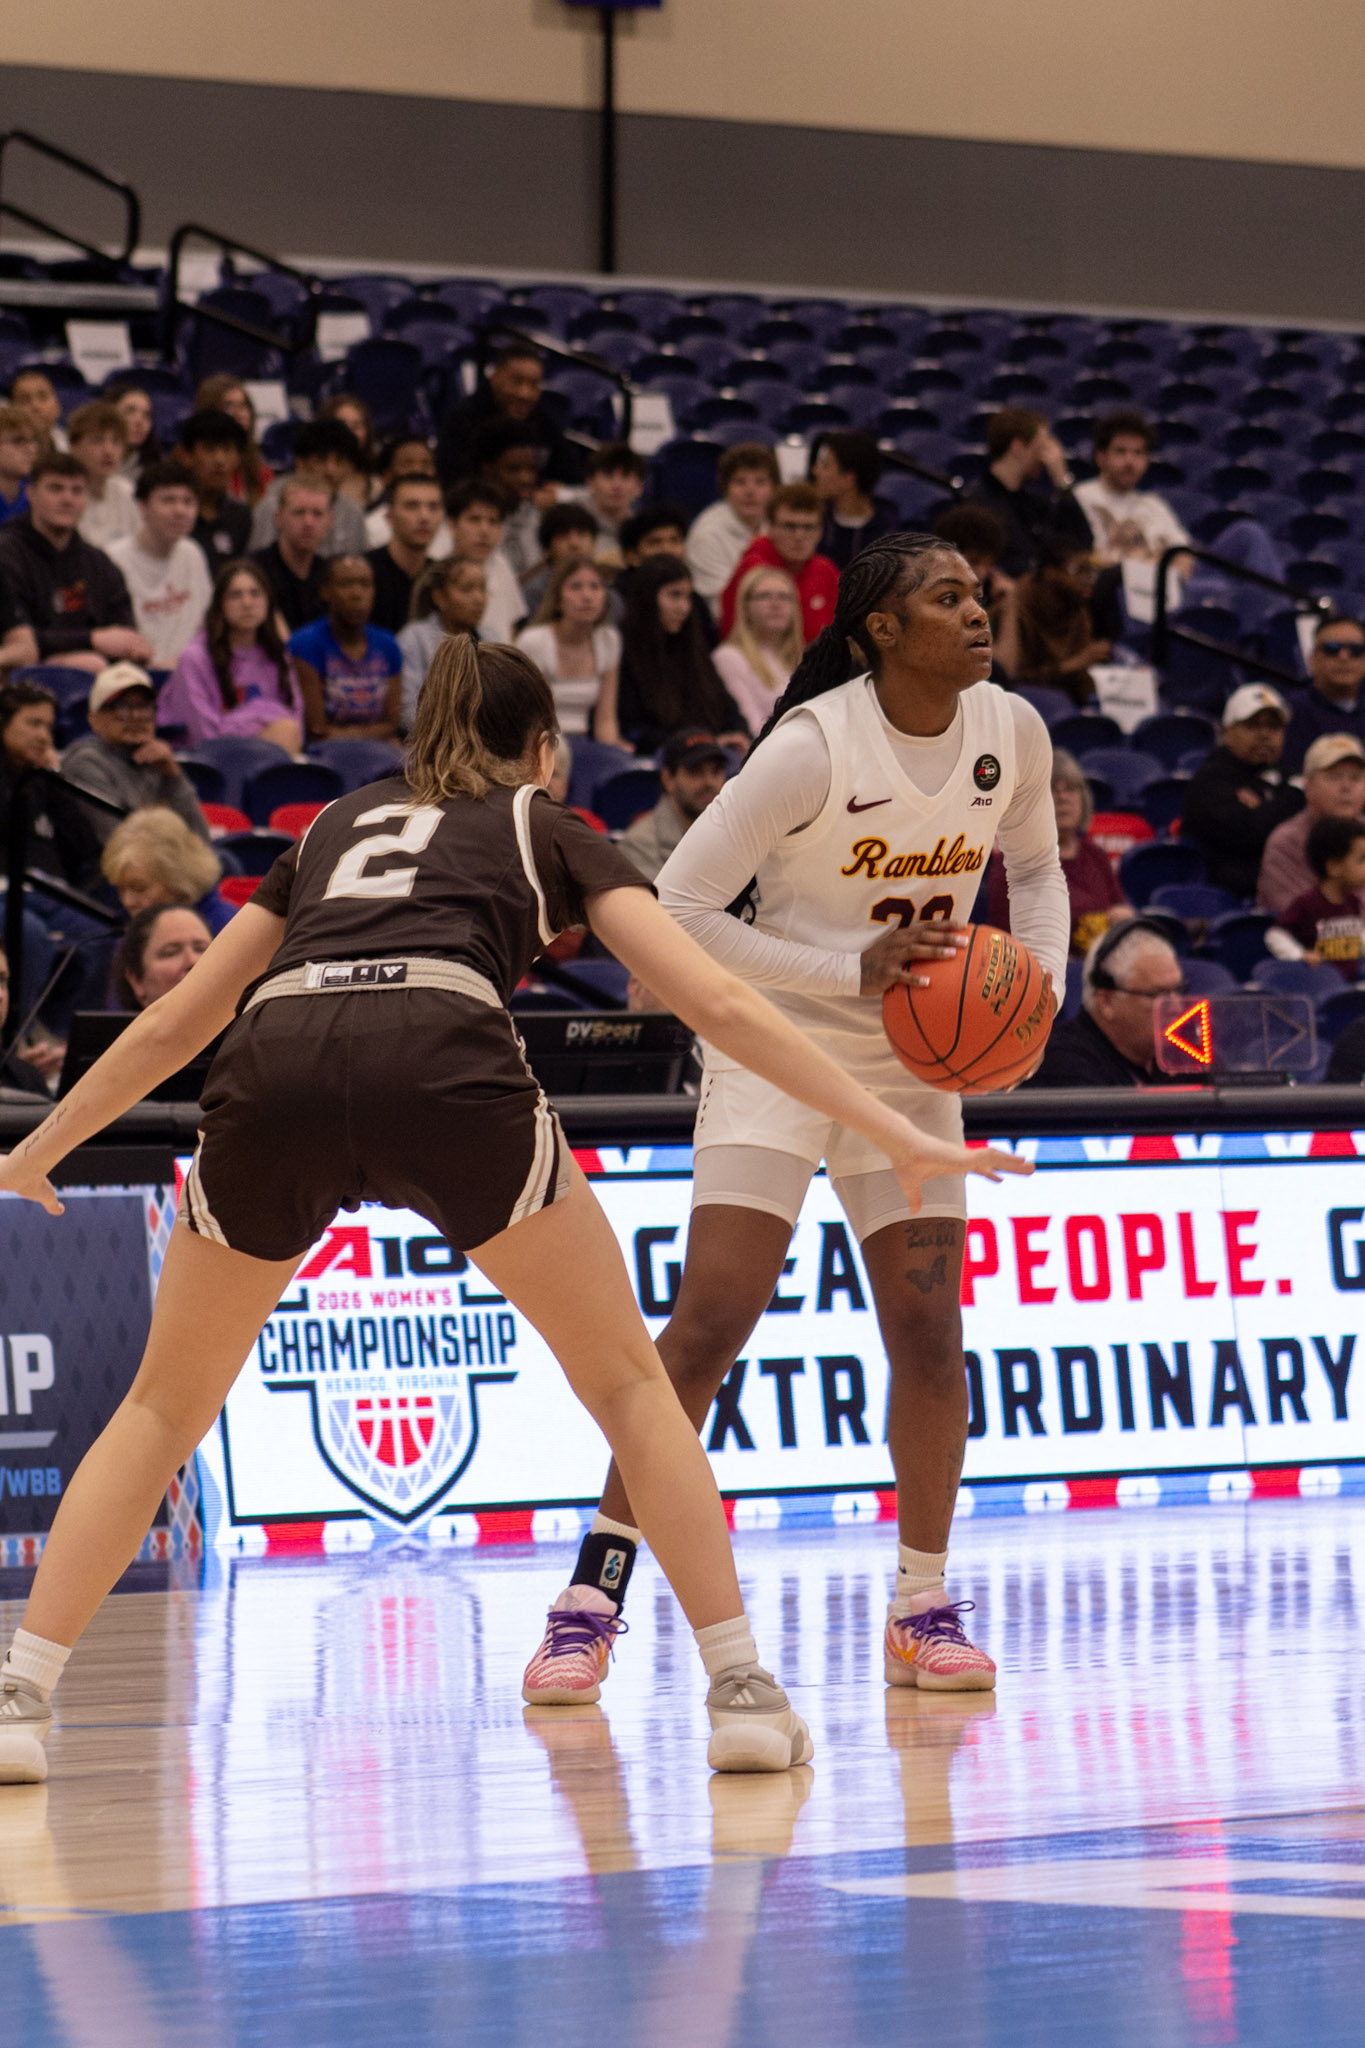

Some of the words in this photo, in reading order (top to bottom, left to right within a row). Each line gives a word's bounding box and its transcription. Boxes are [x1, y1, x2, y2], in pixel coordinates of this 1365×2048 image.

[970, 796, 993, 807] A10
[321, 804, 446, 901] 2
[841, 832, 985, 881] Ramblers
[294, 1225, 469, 1279] A10
[960, 1209, 1293, 1308] PEOPLE.
[316, 1291, 362, 1311] 2026
[369, 1288, 452, 1308] WOMEN'S
[257, 1311, 516, 1375] CHAMPIONSHIP
[396, 1372, 460, 1391] VIRGINIA
